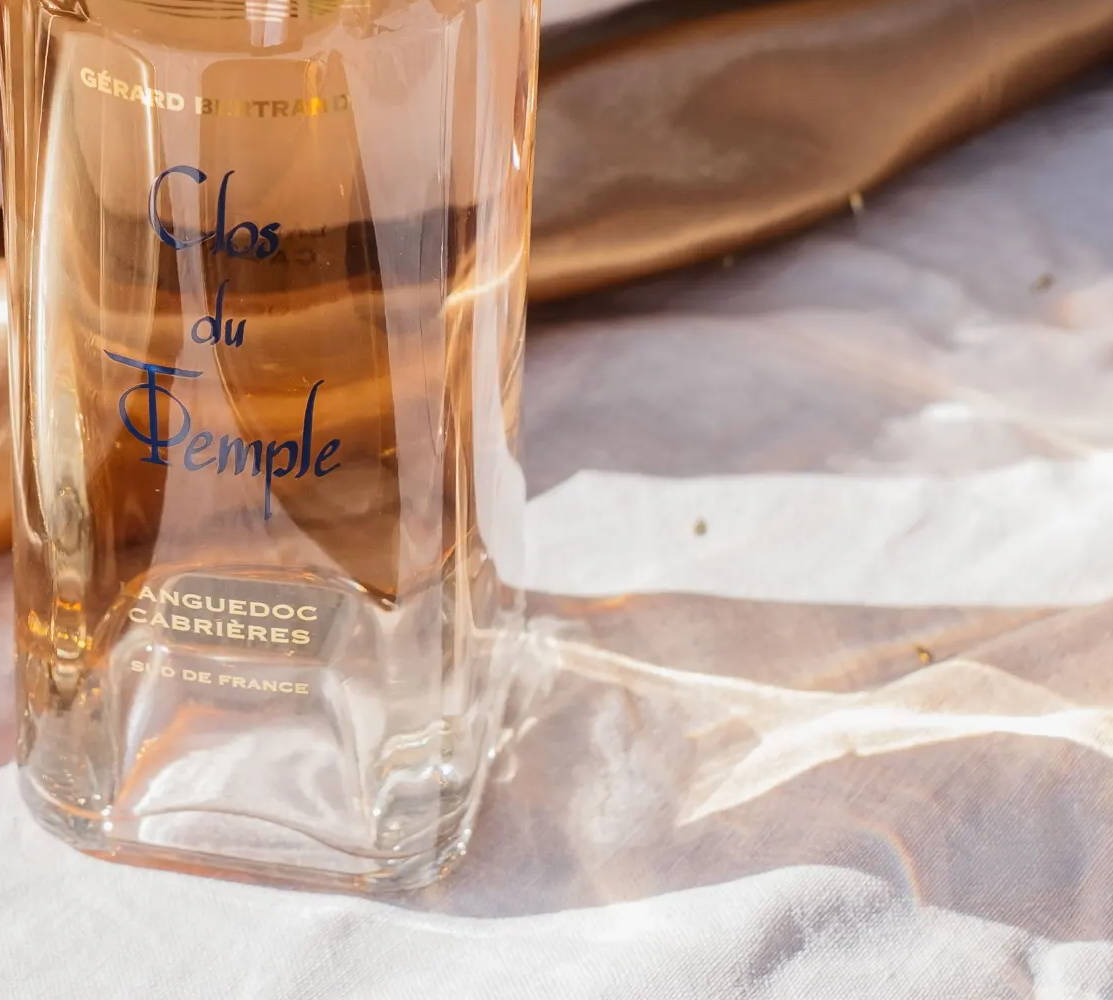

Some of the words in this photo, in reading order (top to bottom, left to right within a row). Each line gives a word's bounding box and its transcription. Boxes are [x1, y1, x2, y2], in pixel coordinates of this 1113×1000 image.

[79, 67, 185, 112] GÉRARD
[147, 165, 281, 260] Clos
[190, 278, 247, 348] du
[127, 607, 311, 645] CABRIÈRES
[182, 669, 212, 684] DE
[218, 674, 310, 695] FRANCE
